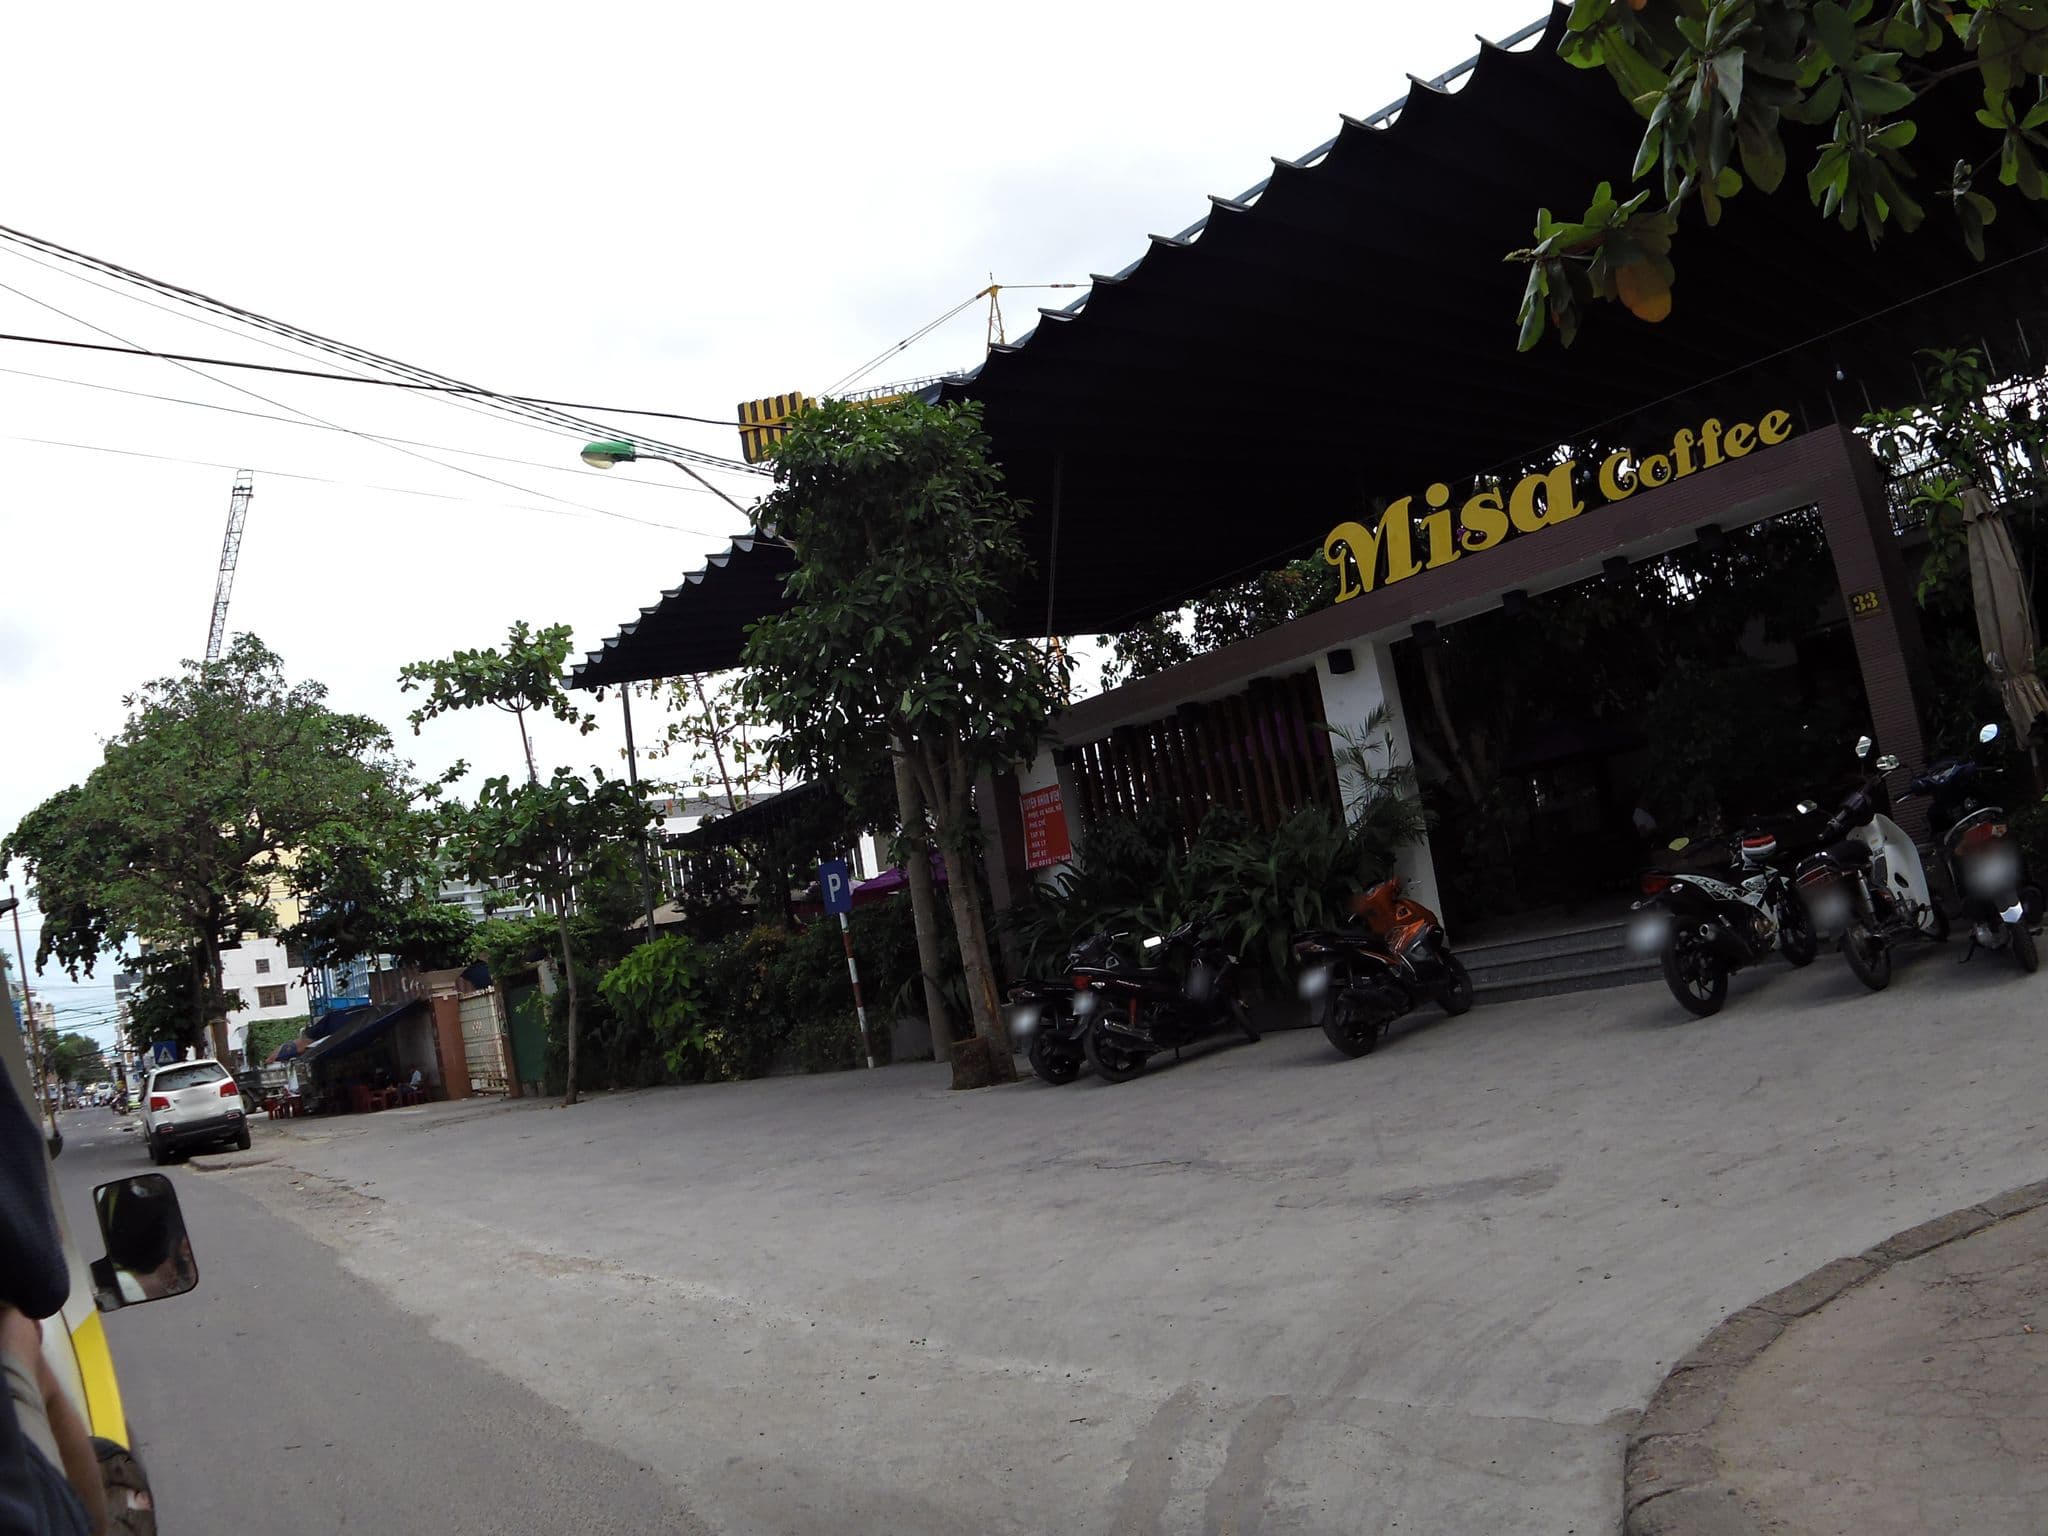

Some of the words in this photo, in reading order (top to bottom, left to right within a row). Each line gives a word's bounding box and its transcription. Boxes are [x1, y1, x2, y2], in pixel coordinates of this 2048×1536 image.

[1323, 459, 1585, 605] Misa
[1599, 408, 1793, 502] Coffee
[828, 873, 841, 903] P
